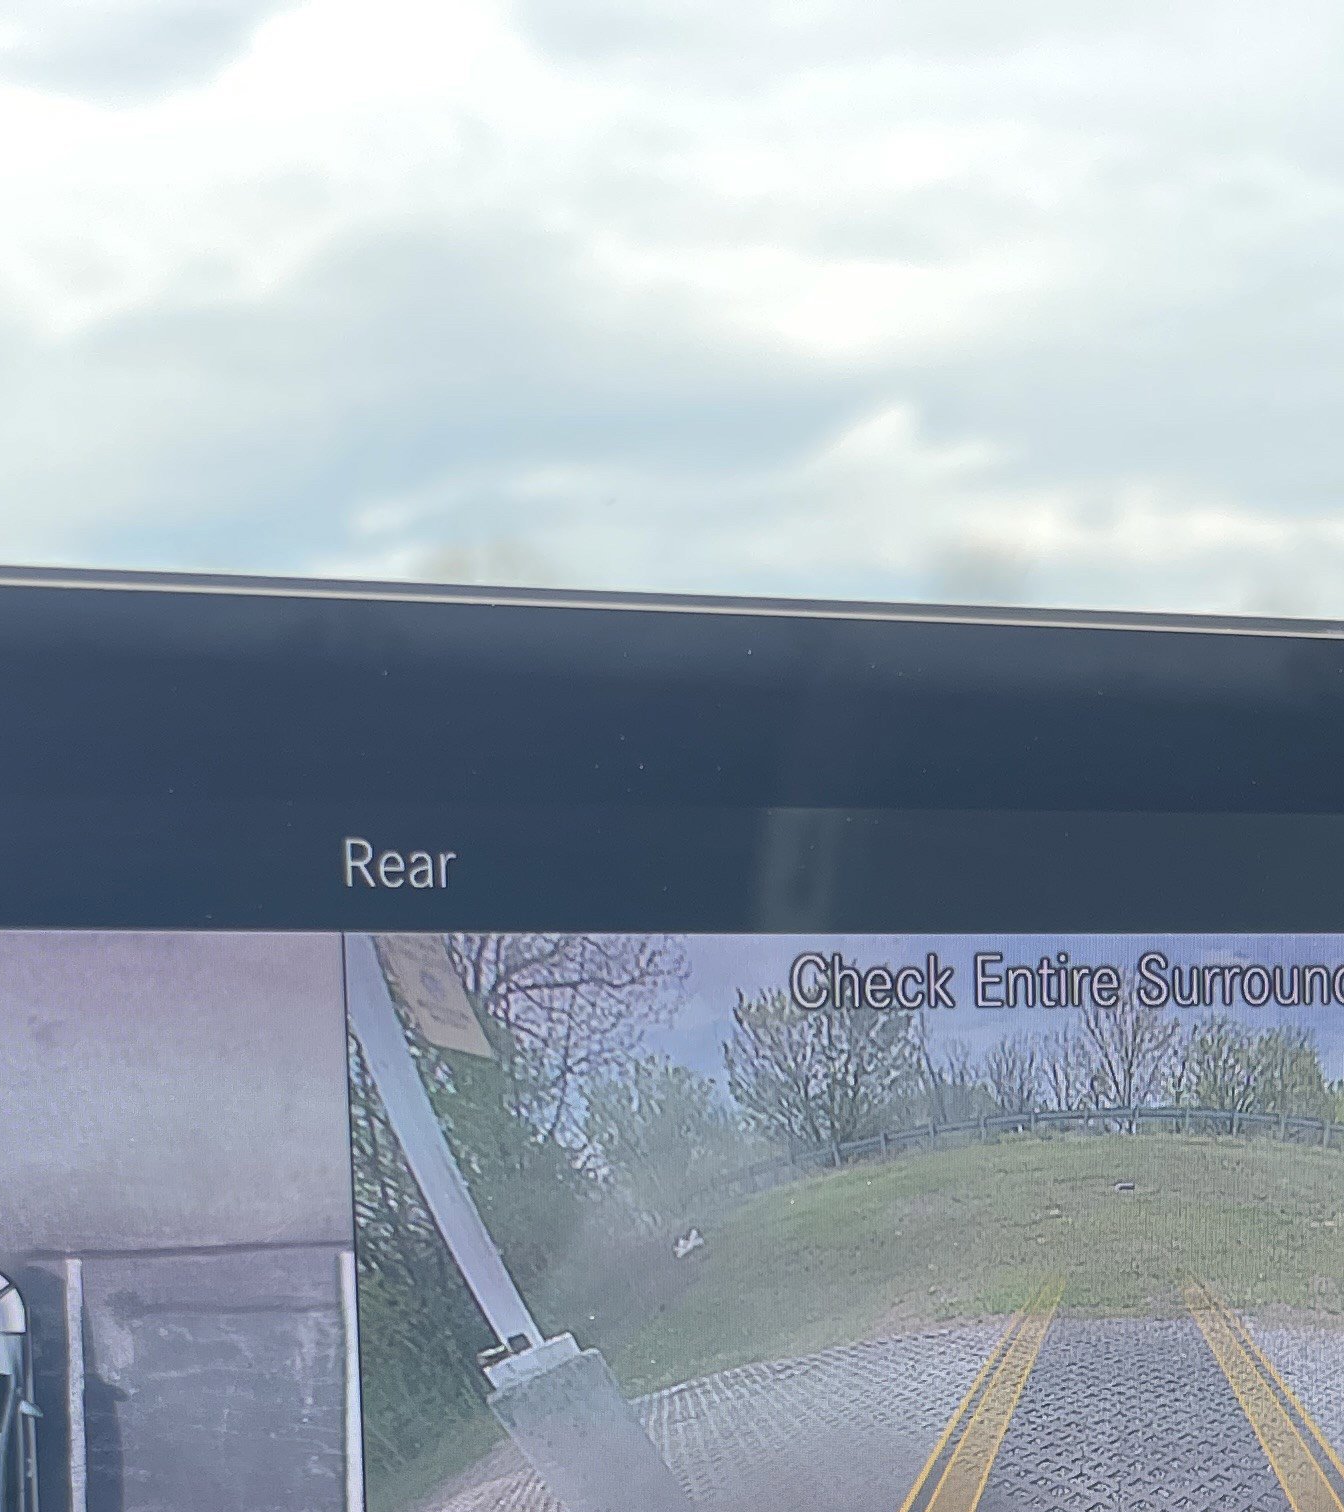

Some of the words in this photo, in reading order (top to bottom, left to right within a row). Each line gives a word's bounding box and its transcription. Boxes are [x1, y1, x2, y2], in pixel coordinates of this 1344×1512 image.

[344, 838, 457, 889] Rear
[788, 951, 955, 1010] Check
[974, 951, 1120, 1010] Entire
